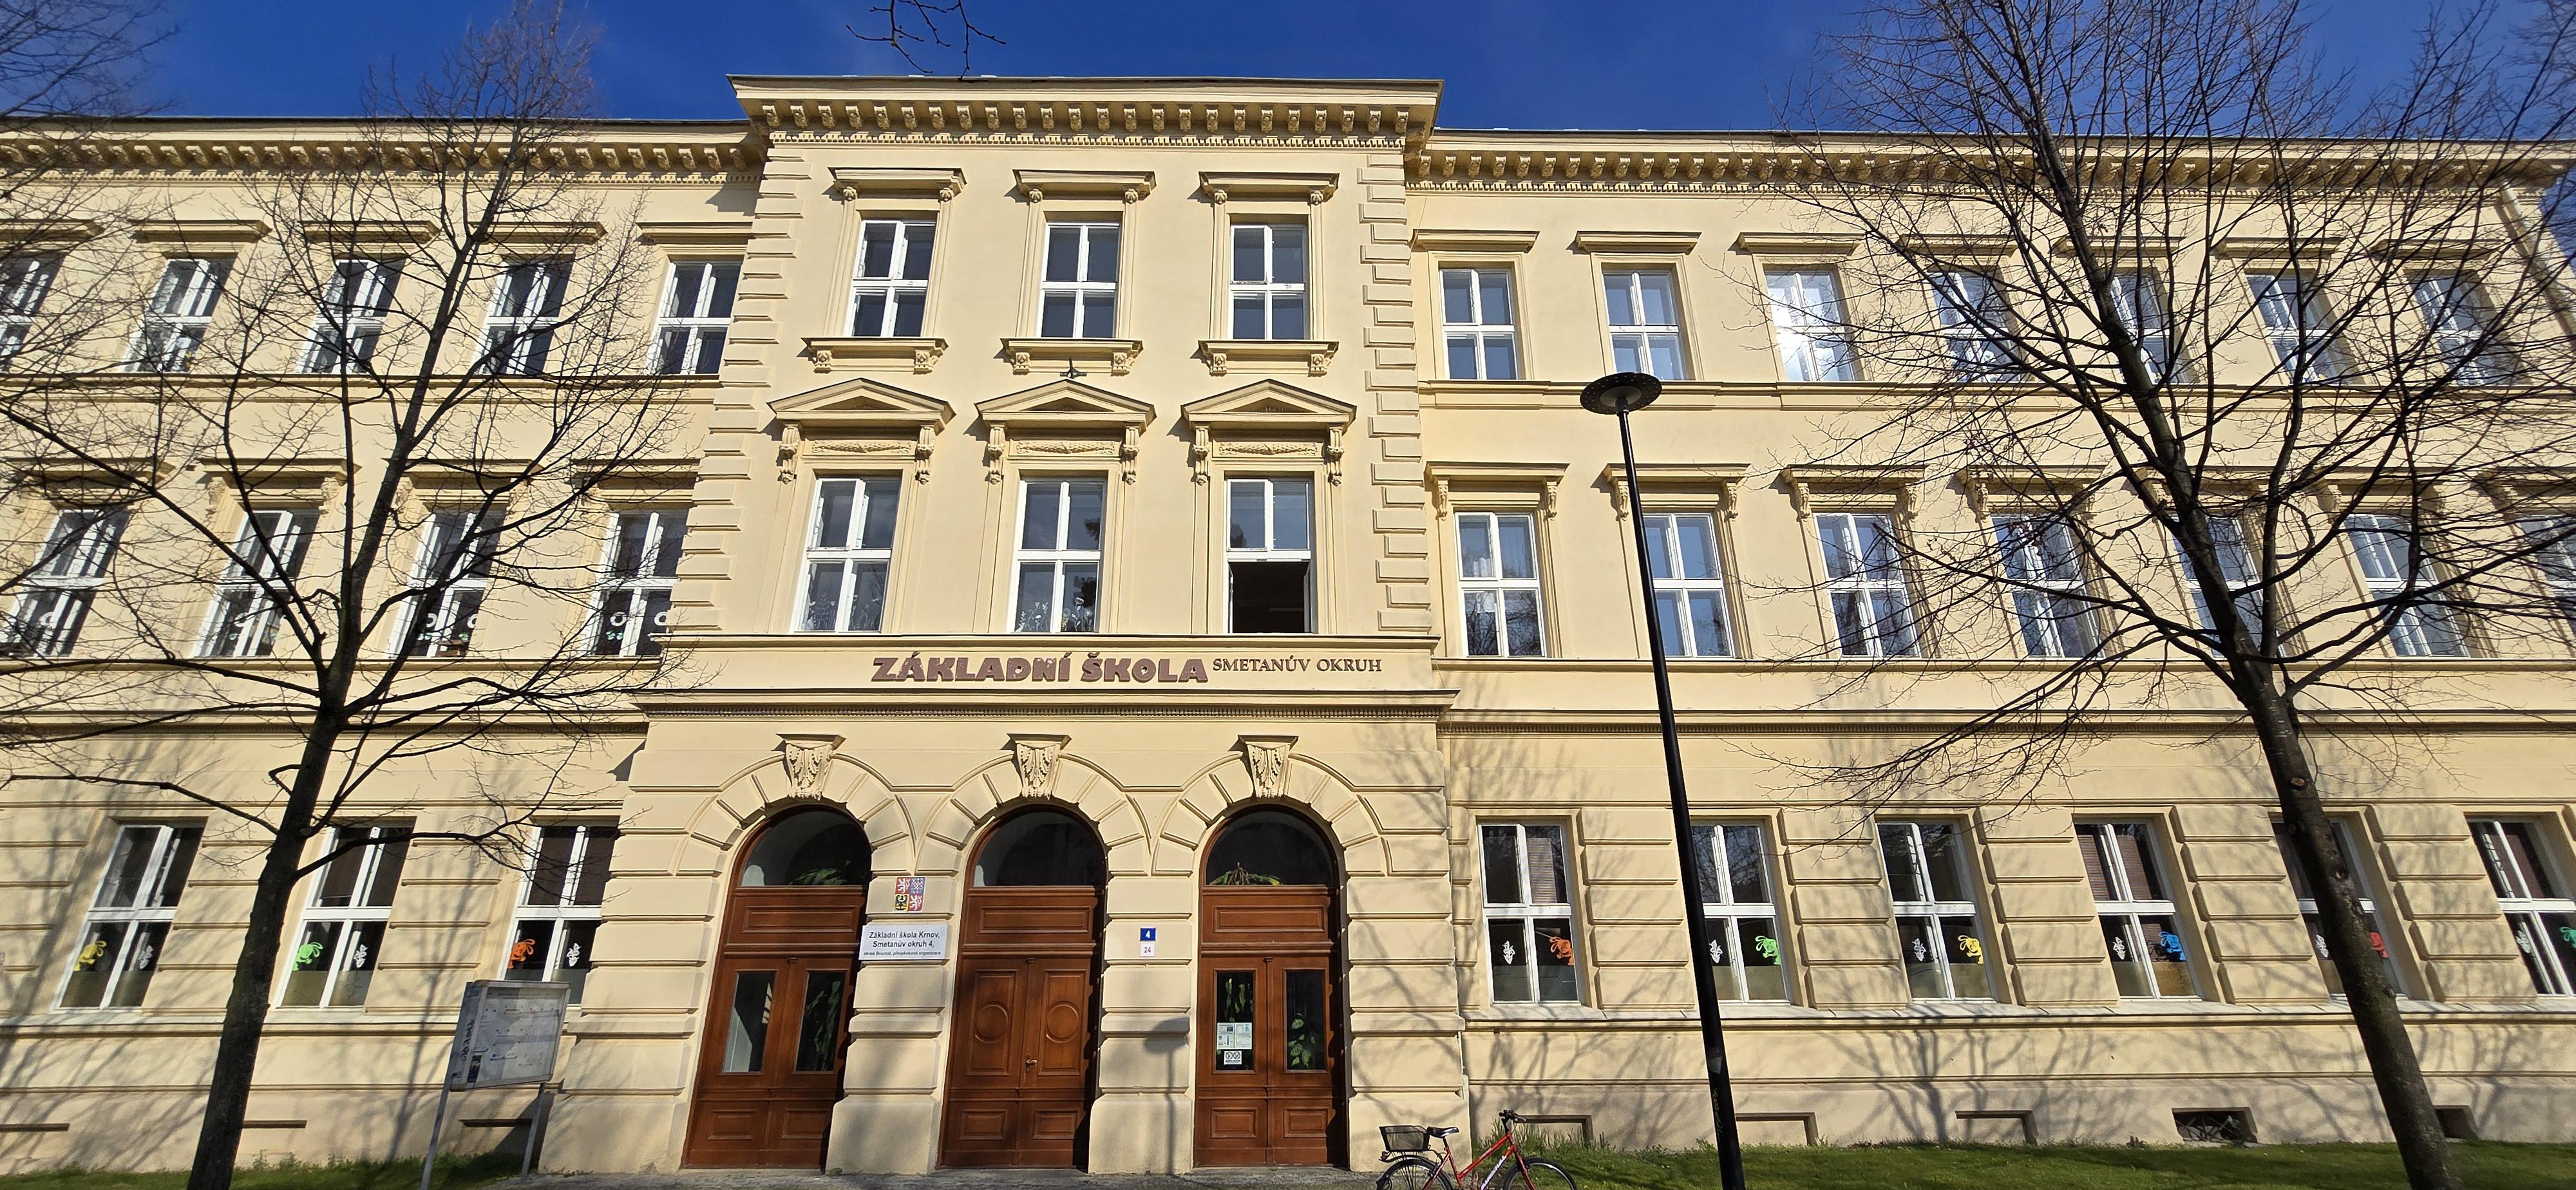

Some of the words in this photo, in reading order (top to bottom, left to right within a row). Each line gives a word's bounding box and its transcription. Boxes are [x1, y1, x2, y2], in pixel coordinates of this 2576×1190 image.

[871, 651, 1072, 682] ZÁKLADNÍ
[1081, 652, 1208, 683] ŠKOLA
[1316, 658, 1382, 672] OKRUH
